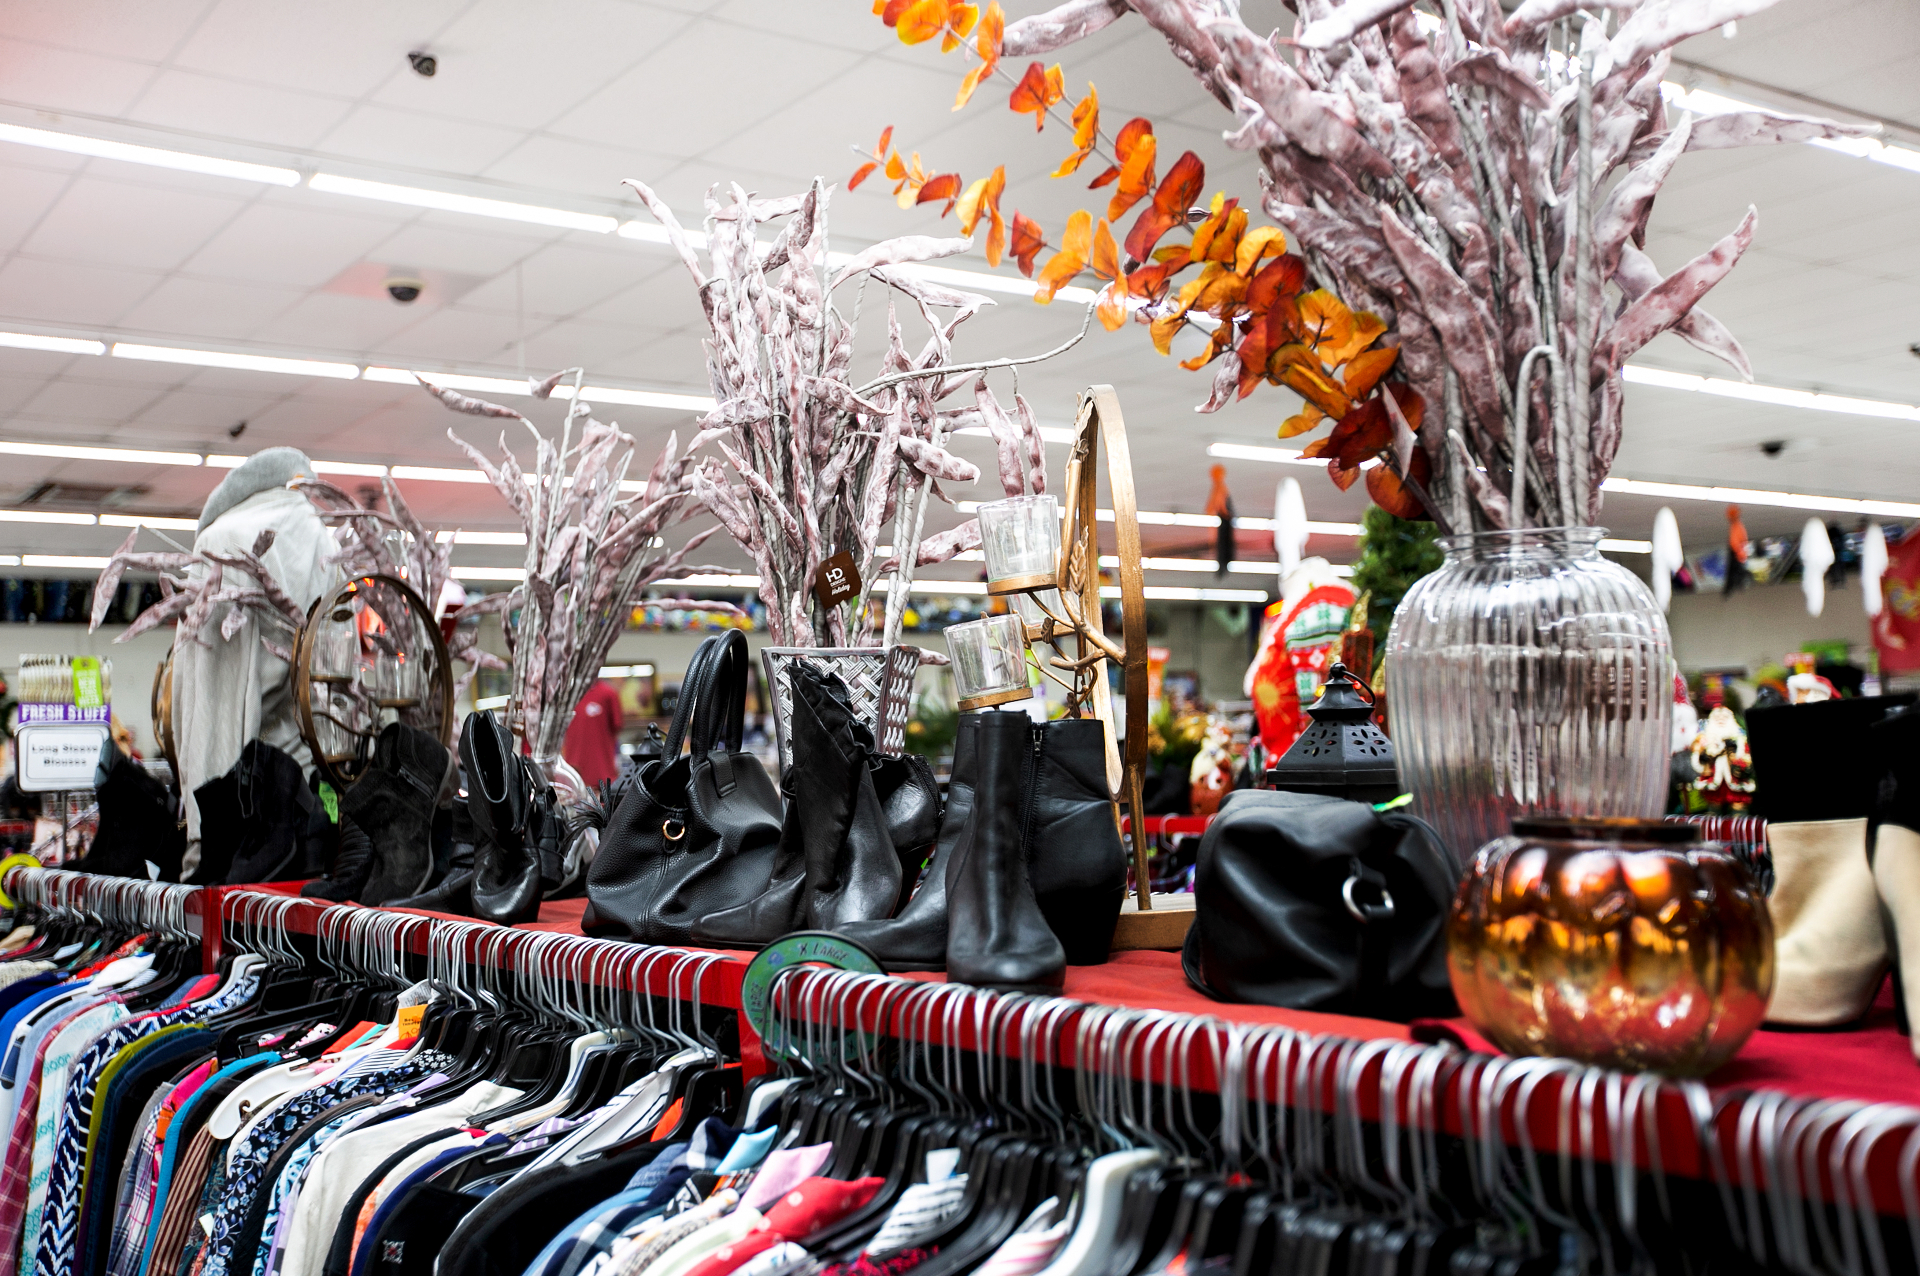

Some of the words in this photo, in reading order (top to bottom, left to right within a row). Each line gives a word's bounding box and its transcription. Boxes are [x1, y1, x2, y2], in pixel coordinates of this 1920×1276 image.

[825, 567, 844, 583] HD
[831, 584, 851, 596] Holiday
[21, 704, 64, 721] FRESH
[67, 704, 108, 721] STUFF
[32, 743, 59, 754] Long
[62, 743, 99, 754] Sleeve
[43, 757, 87, 768] Blouses
[798, 942, 808, 956] X
[813, 942, 850, 962] LARGE
